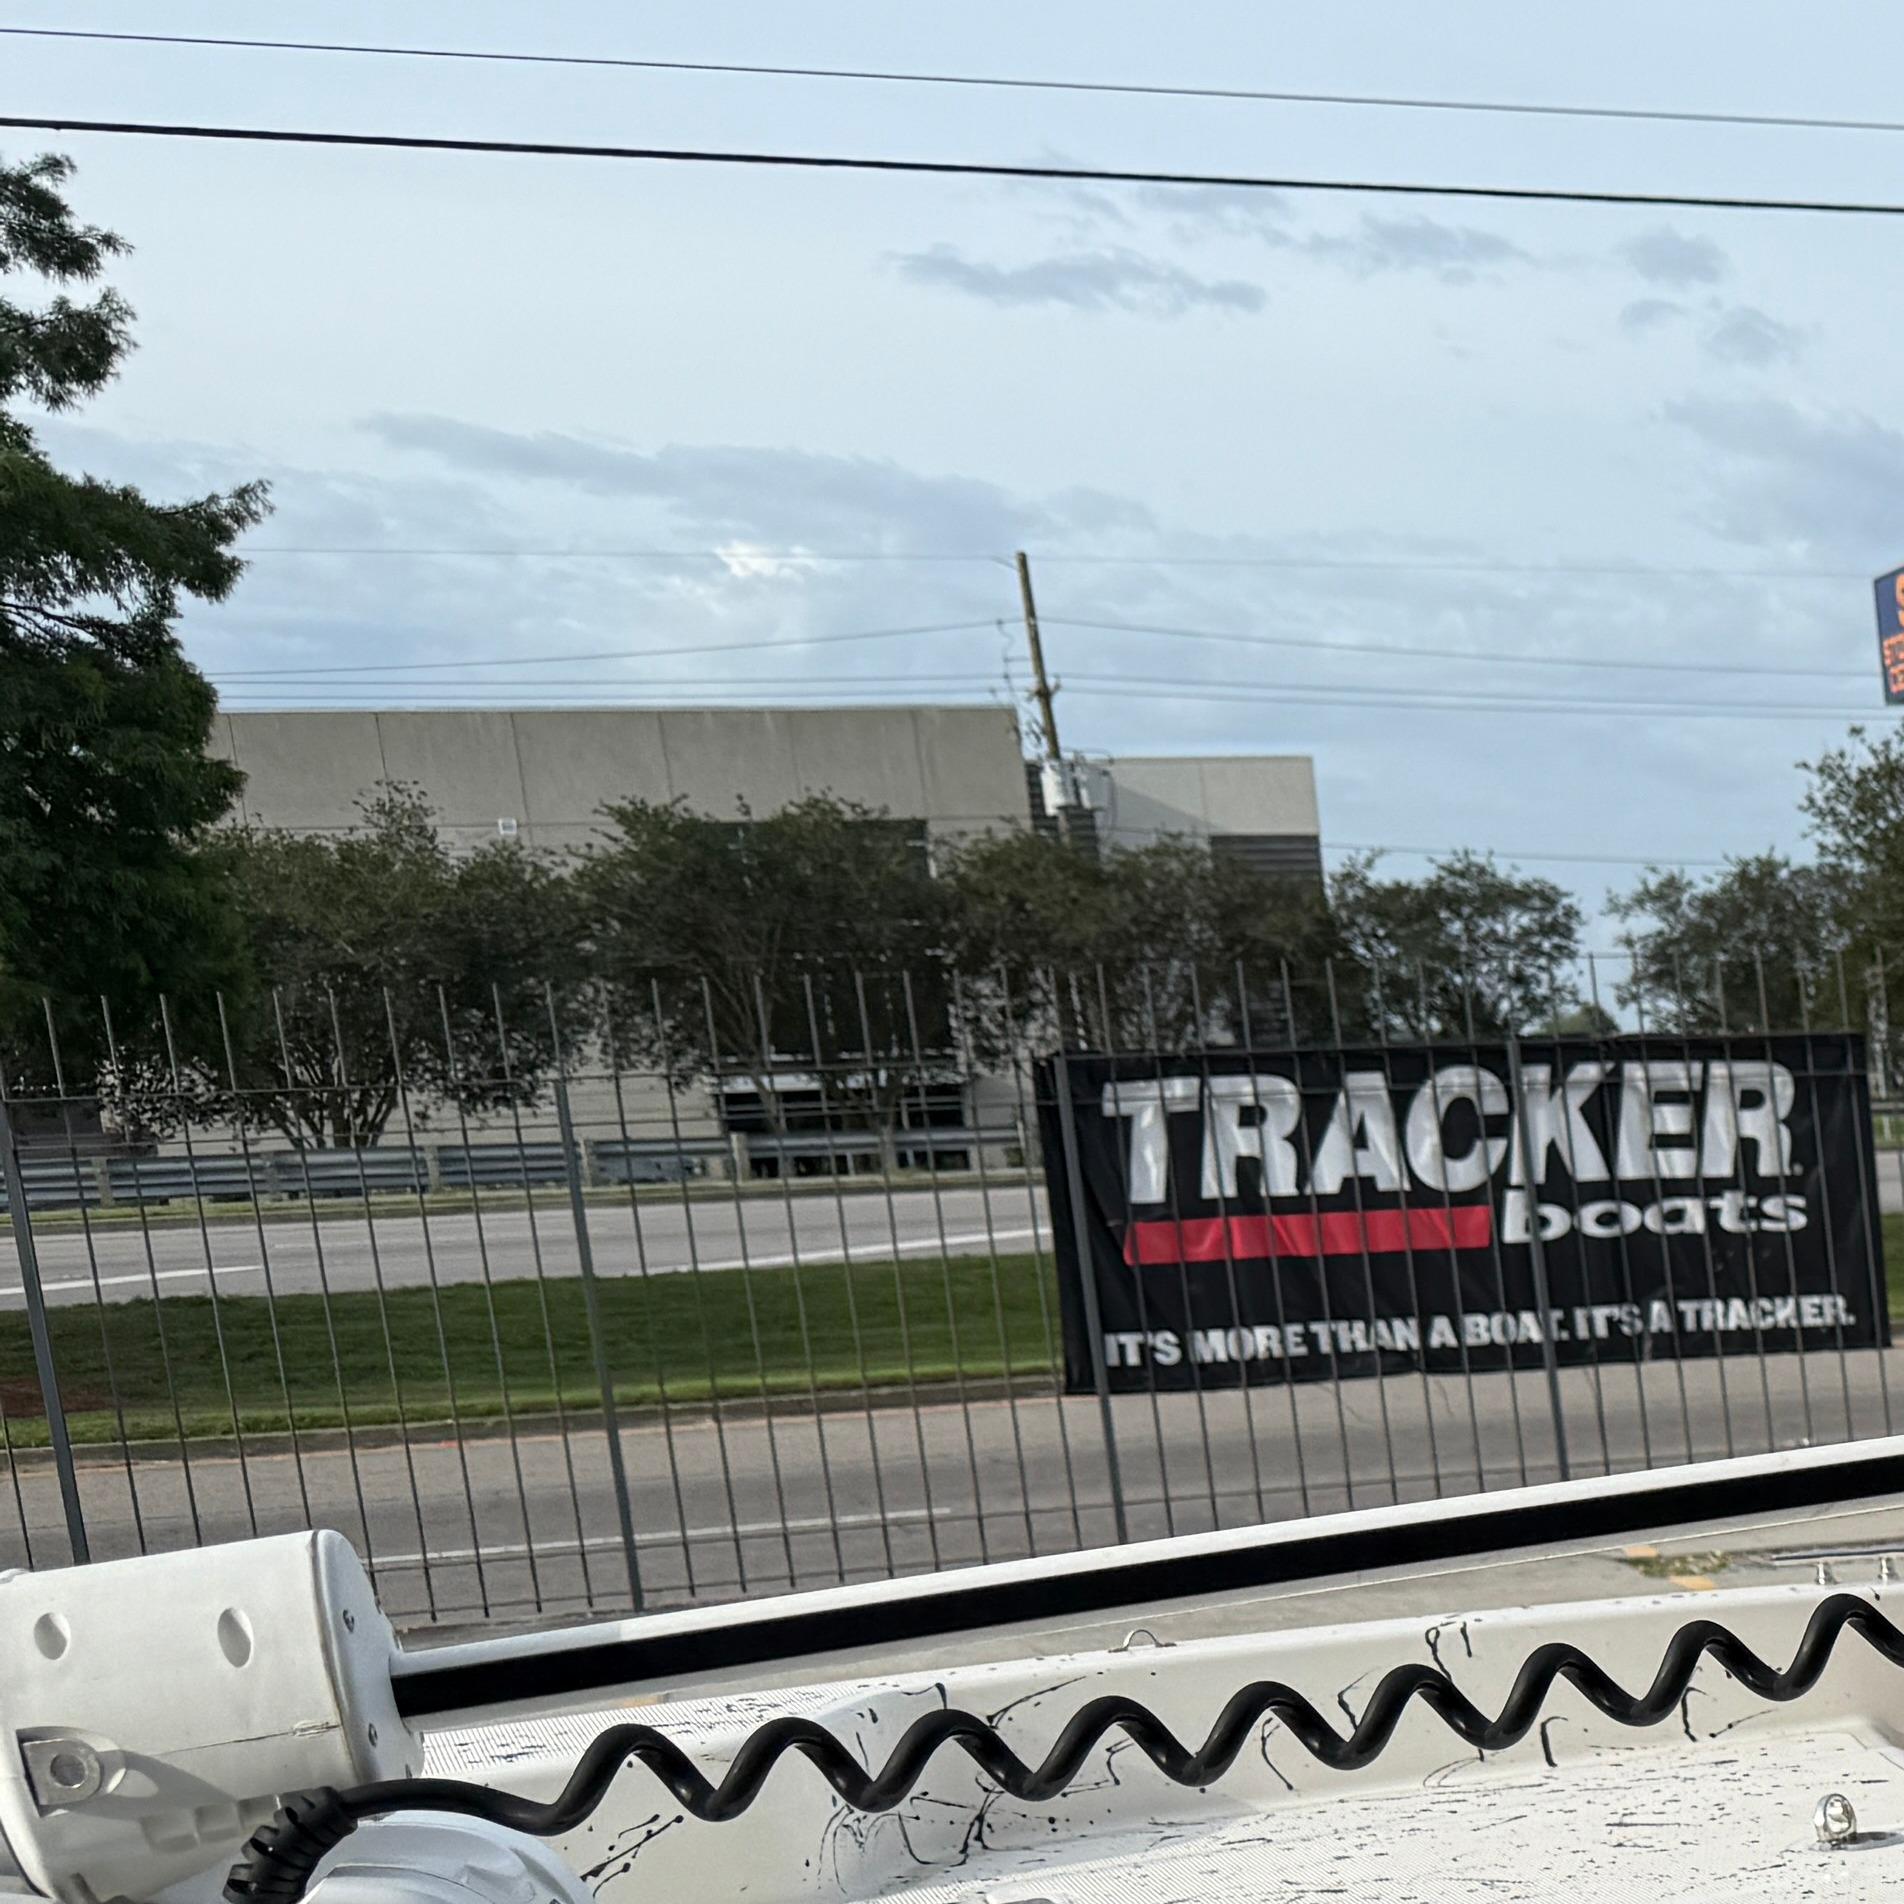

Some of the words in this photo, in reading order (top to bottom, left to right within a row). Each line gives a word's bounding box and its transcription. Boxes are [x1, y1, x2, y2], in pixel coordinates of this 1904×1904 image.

[1102, 1060, 1797, 1204] TRACKER
[1503, 1189, 1808, 1244] boats
[1104, 1329, 1182, 1367] IT'S
[1190, 1322, 1308, 1364] MORE
[1310, 1316, 1420, 1355] THAN
[1429, 1314, 1459, 1348] A
[1574, 1303, 1644, 1338] IT'S
[1650, 1299, 1675, 1334] A
[1677, 1294, 1857, 1331] TRACKER.
